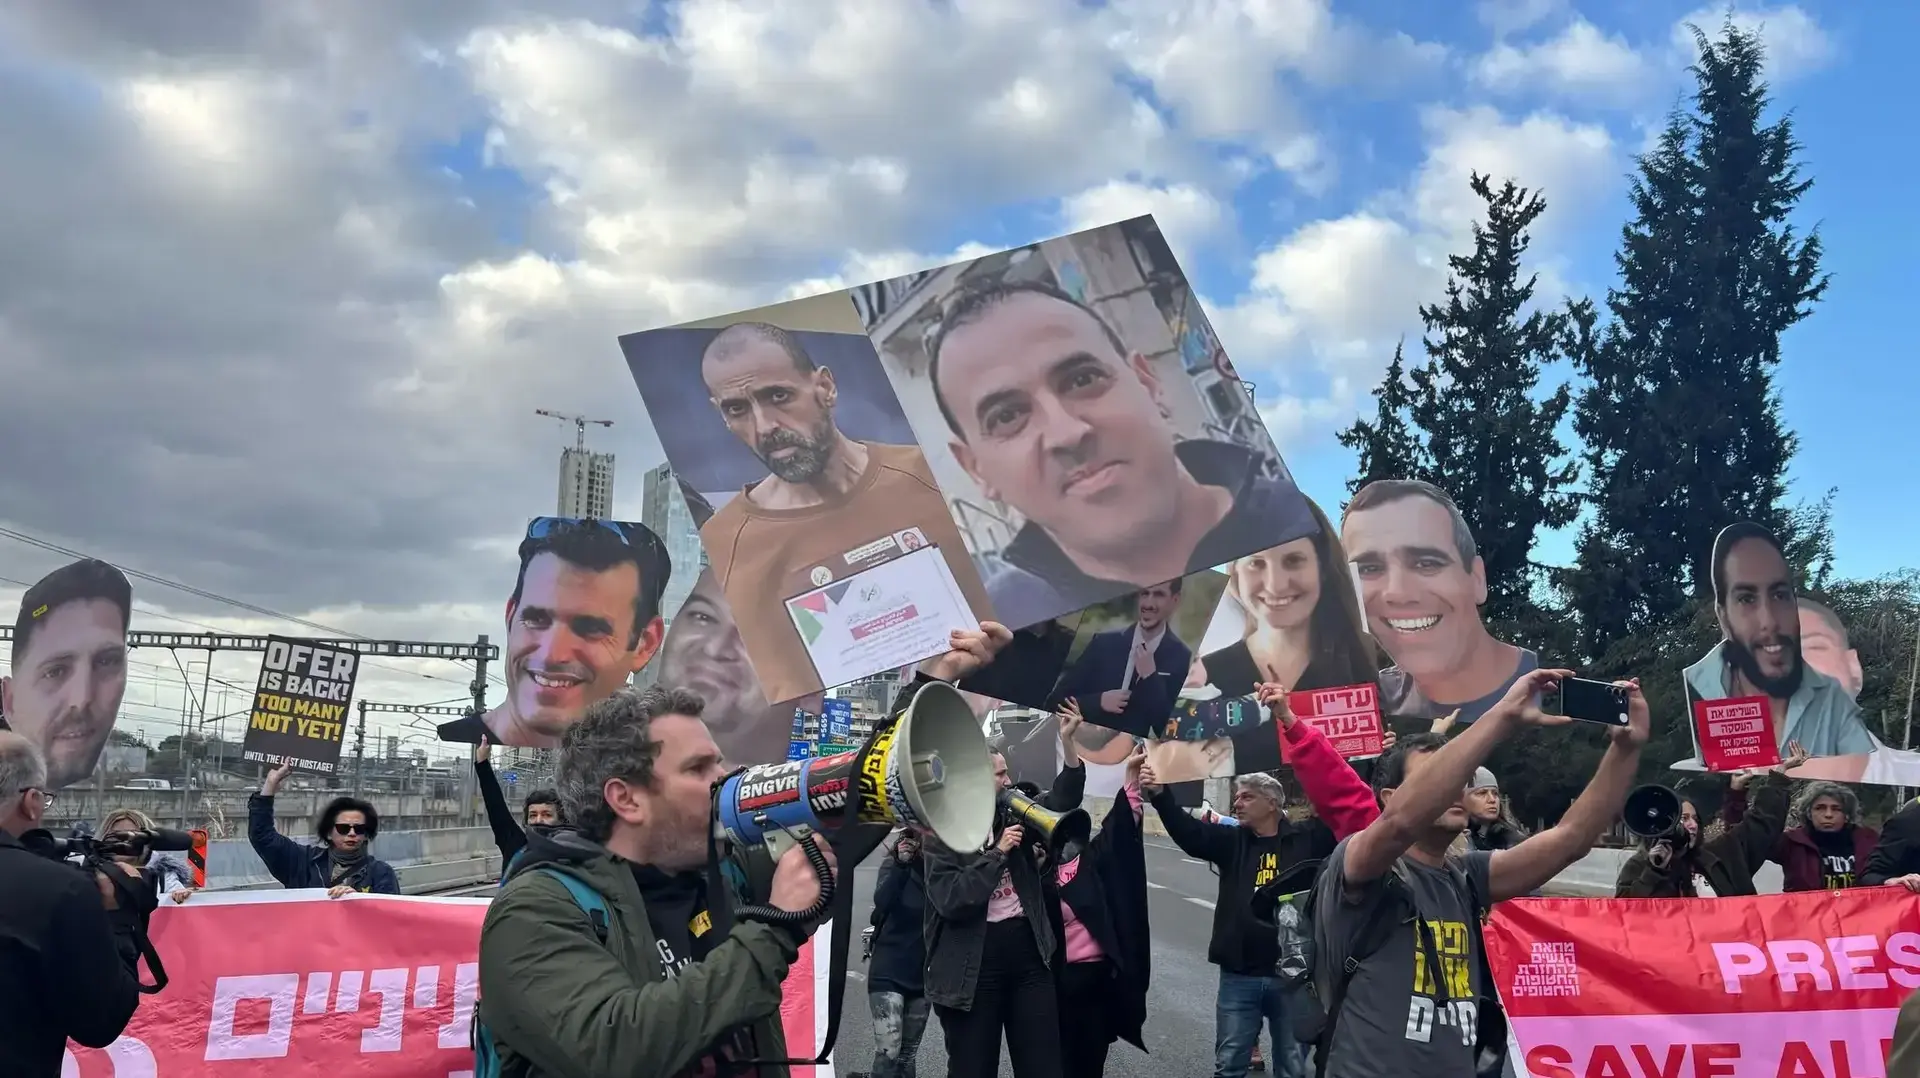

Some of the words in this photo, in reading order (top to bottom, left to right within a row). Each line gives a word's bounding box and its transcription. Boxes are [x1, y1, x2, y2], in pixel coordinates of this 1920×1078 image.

[265, 640, 355, 682] OFER
[260, 670, 282, 691] IS
[285, 674, 350, 702] BACK!
[258, 692, 292, 713] TOO
[293, 699, 345, 721] MANY
[1316, 689, 1371, 714] עדיין
[1711, 708, 1724, 719] את
[1726, 705, 1759, 718] השלימו
[251, 711, 293, 734] NOT
[297, 717, 342, 741] YET!
[1720, 721, 1753, 733] העסקה
[1720, 739, 1732, 747] את
[1734, 736, 1761, 747] הפסיקו
[1724, 745, 1761, 757] המלחמה!
[244, 750, 265, 762] UNTIL
[266, 753, 281, 765] THE
[281, 755, 300, 767] LST
[300, 758, 334, 772] HOSTAGE!
[740, 774, 800, 799] BNGVR
[1531, 942, 1575, 953] מחאת
[1530, 953, 1576, 964] הנשים
[1517, 962, 1577, 974] להחזרת
[1514, 974, 1579, 985] החטופות
[1511, 985, 1581, 997] והחטופים
[1525, 1042, 1742, 1078] SAVE
